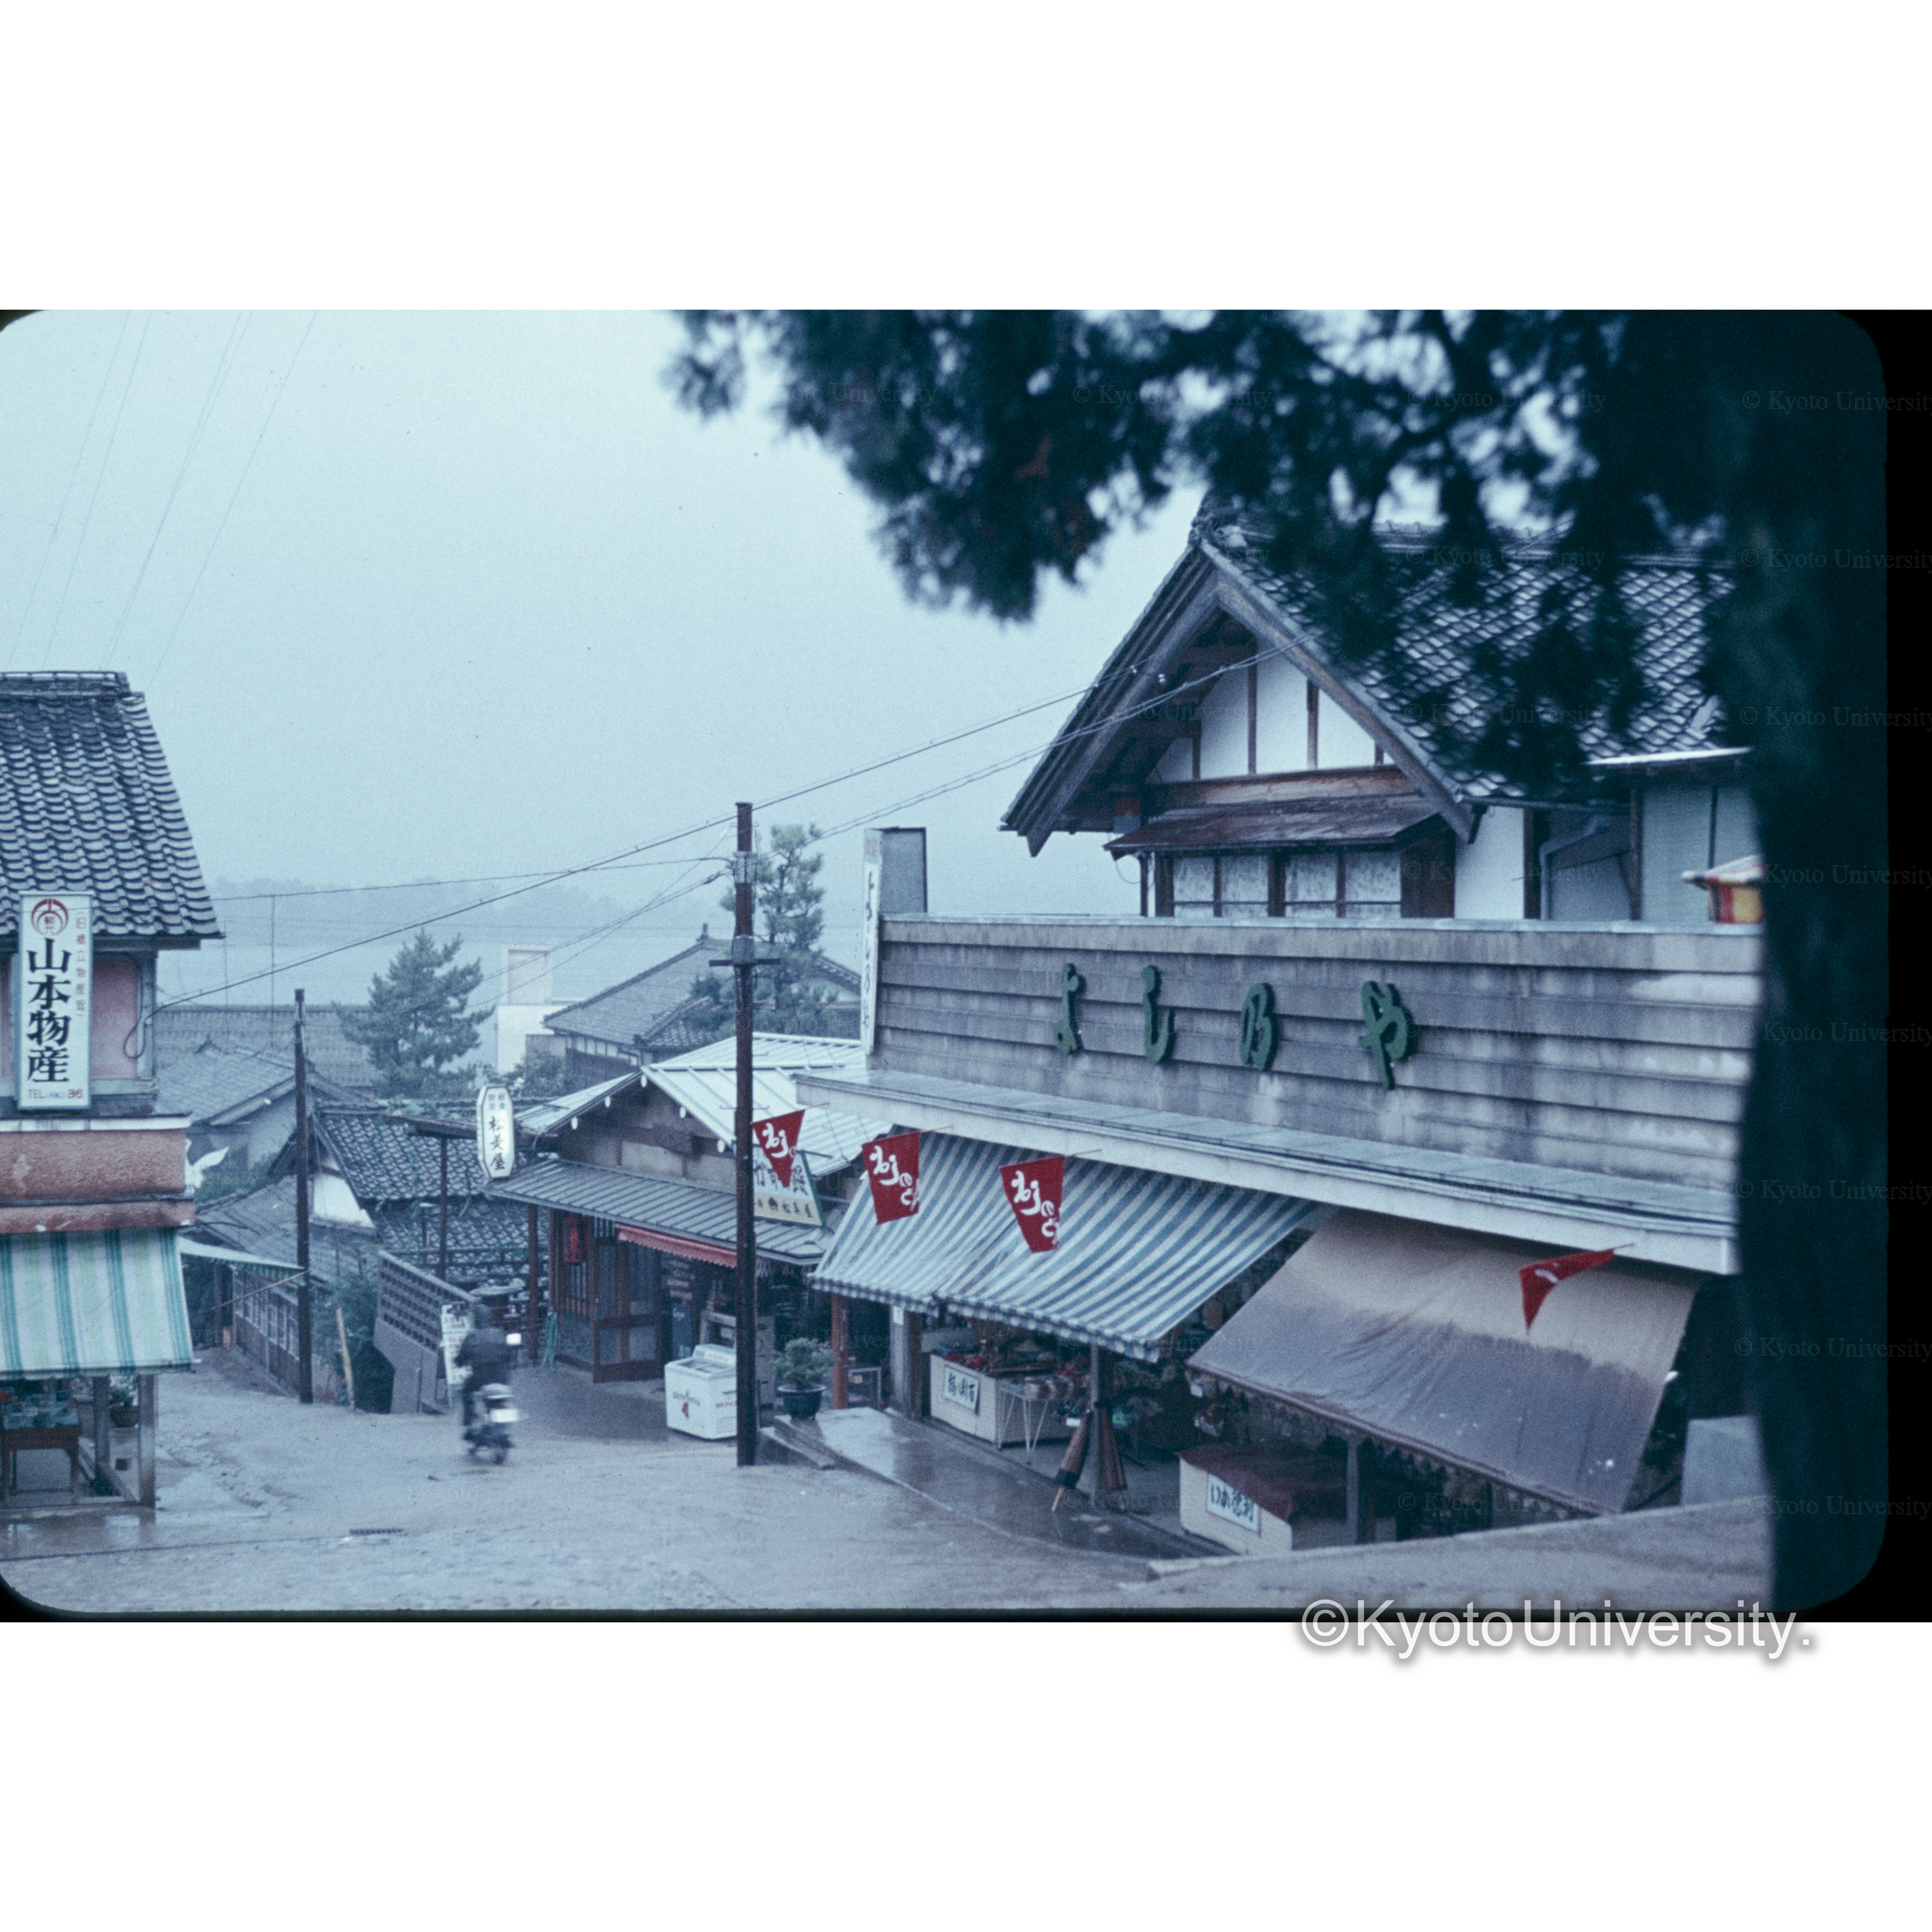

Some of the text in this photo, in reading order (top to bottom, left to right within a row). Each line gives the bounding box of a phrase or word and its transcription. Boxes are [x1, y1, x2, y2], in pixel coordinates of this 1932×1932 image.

[27, 937, 72, 1083] 山本物産
[1053, 963, 1416, 1090] よしのや
[28, 1089, 45, 1099] TEL
[68, 1089, 83, 1099] 36
[488, 1115, 505, 1170] 松美屋
